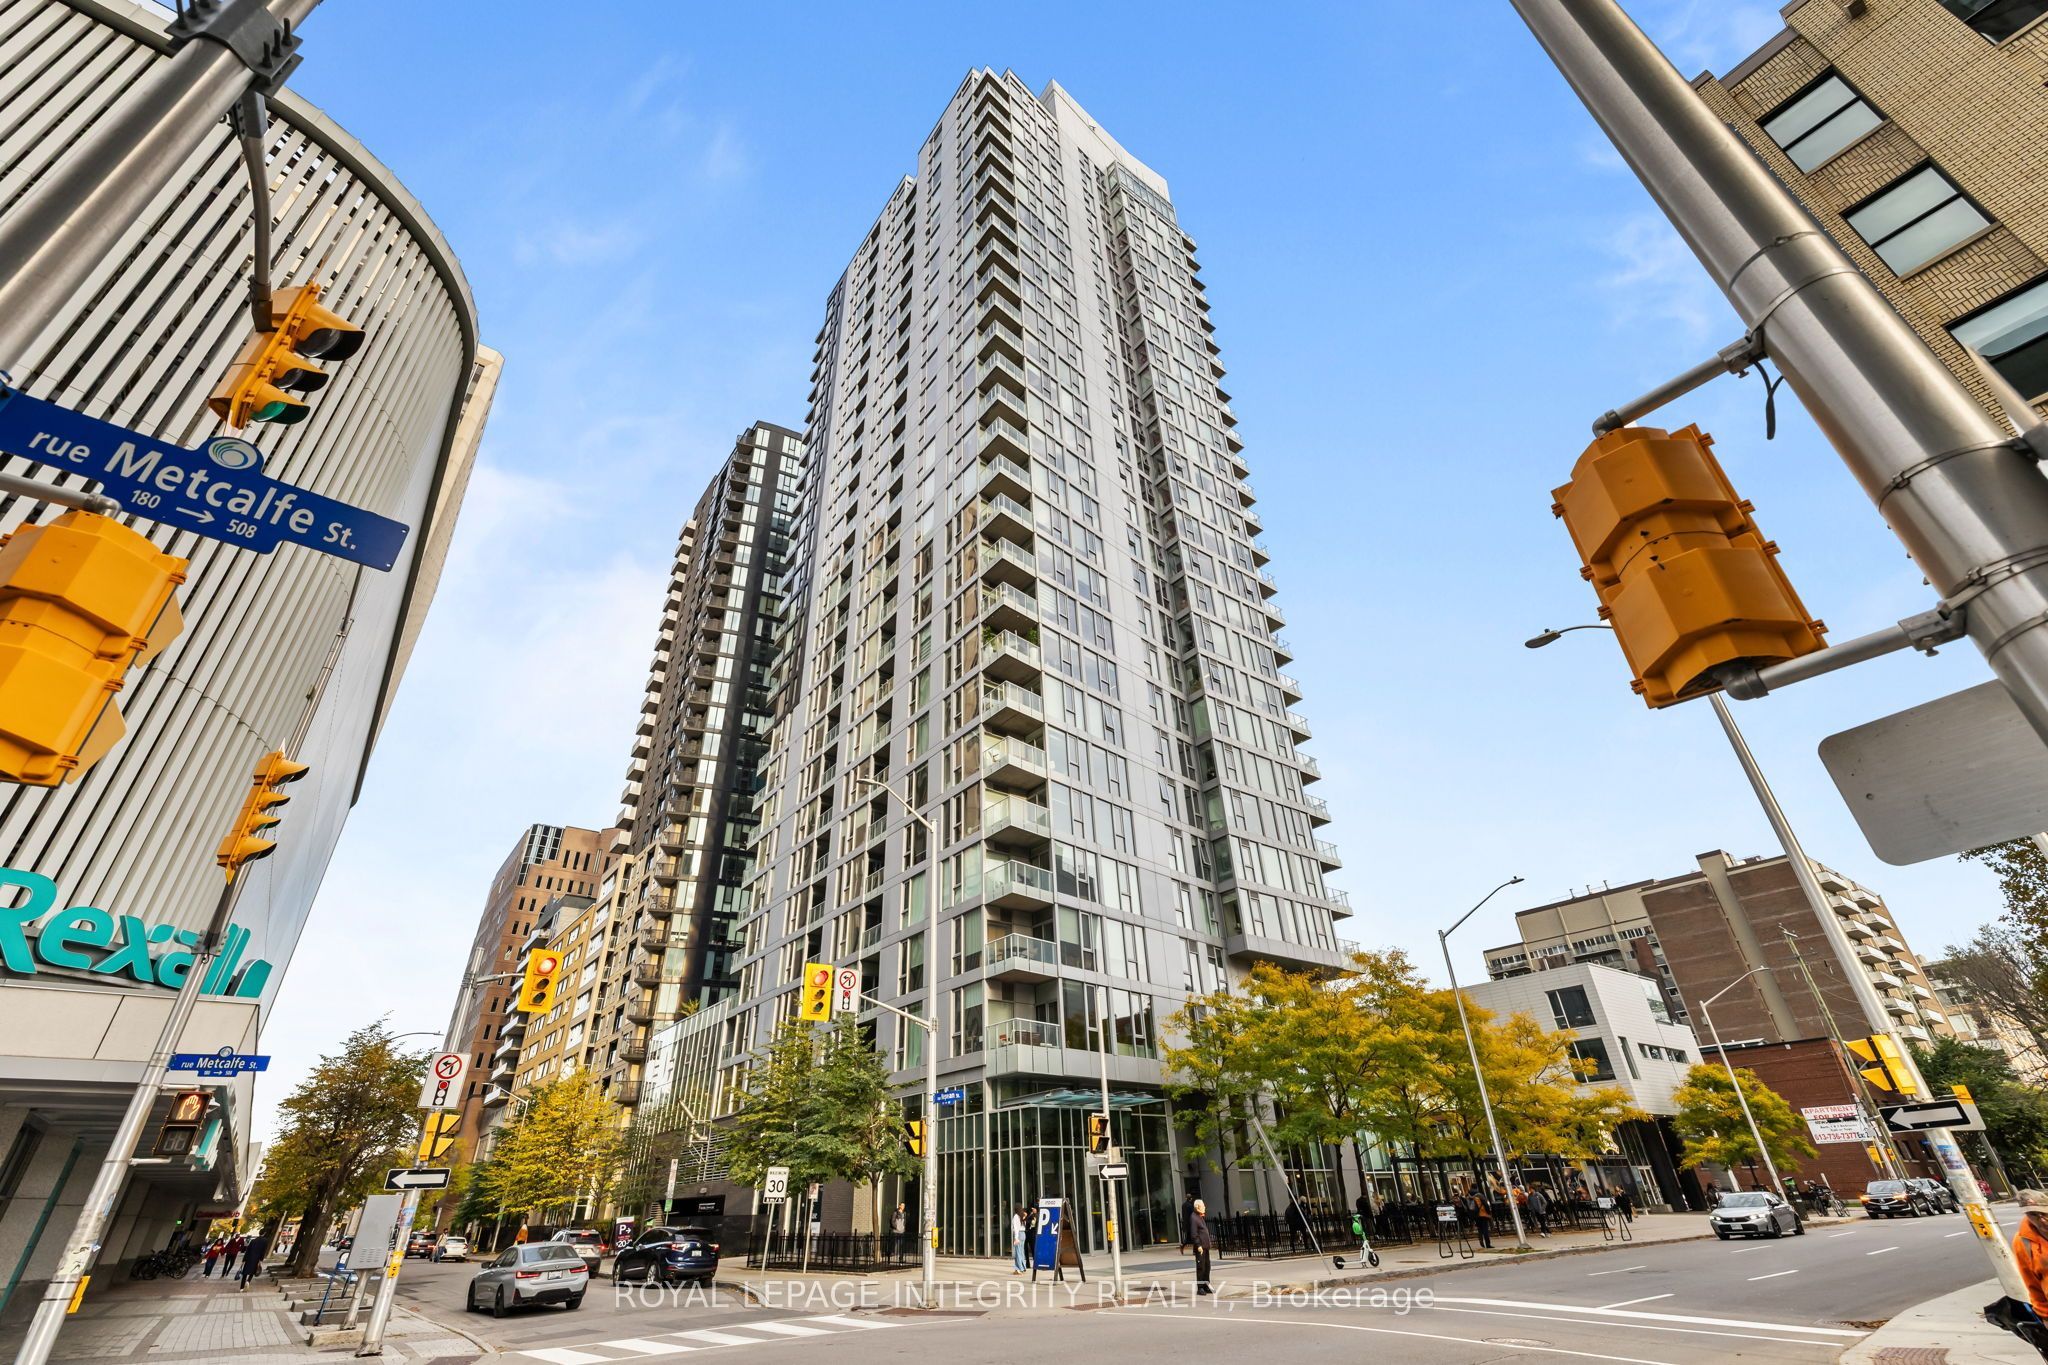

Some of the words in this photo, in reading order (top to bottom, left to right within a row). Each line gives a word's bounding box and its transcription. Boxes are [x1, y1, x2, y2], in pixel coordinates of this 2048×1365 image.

[28, 431, 90, 463] rue
[104, 441, 315, 534] Metcalfe
[323, 522, 356, 550] St.
[130, 490, 161, 509] 180
[226, 519, 257, 539] 508
[196, 1057, 246, 1069] Metcalfe
[248, 1061, 258, 1069] St.
[768, 1180, 784, 1193] 30
[618, 1224, 627, 1235] P
[1037, 1208, 1050, 1235] P
